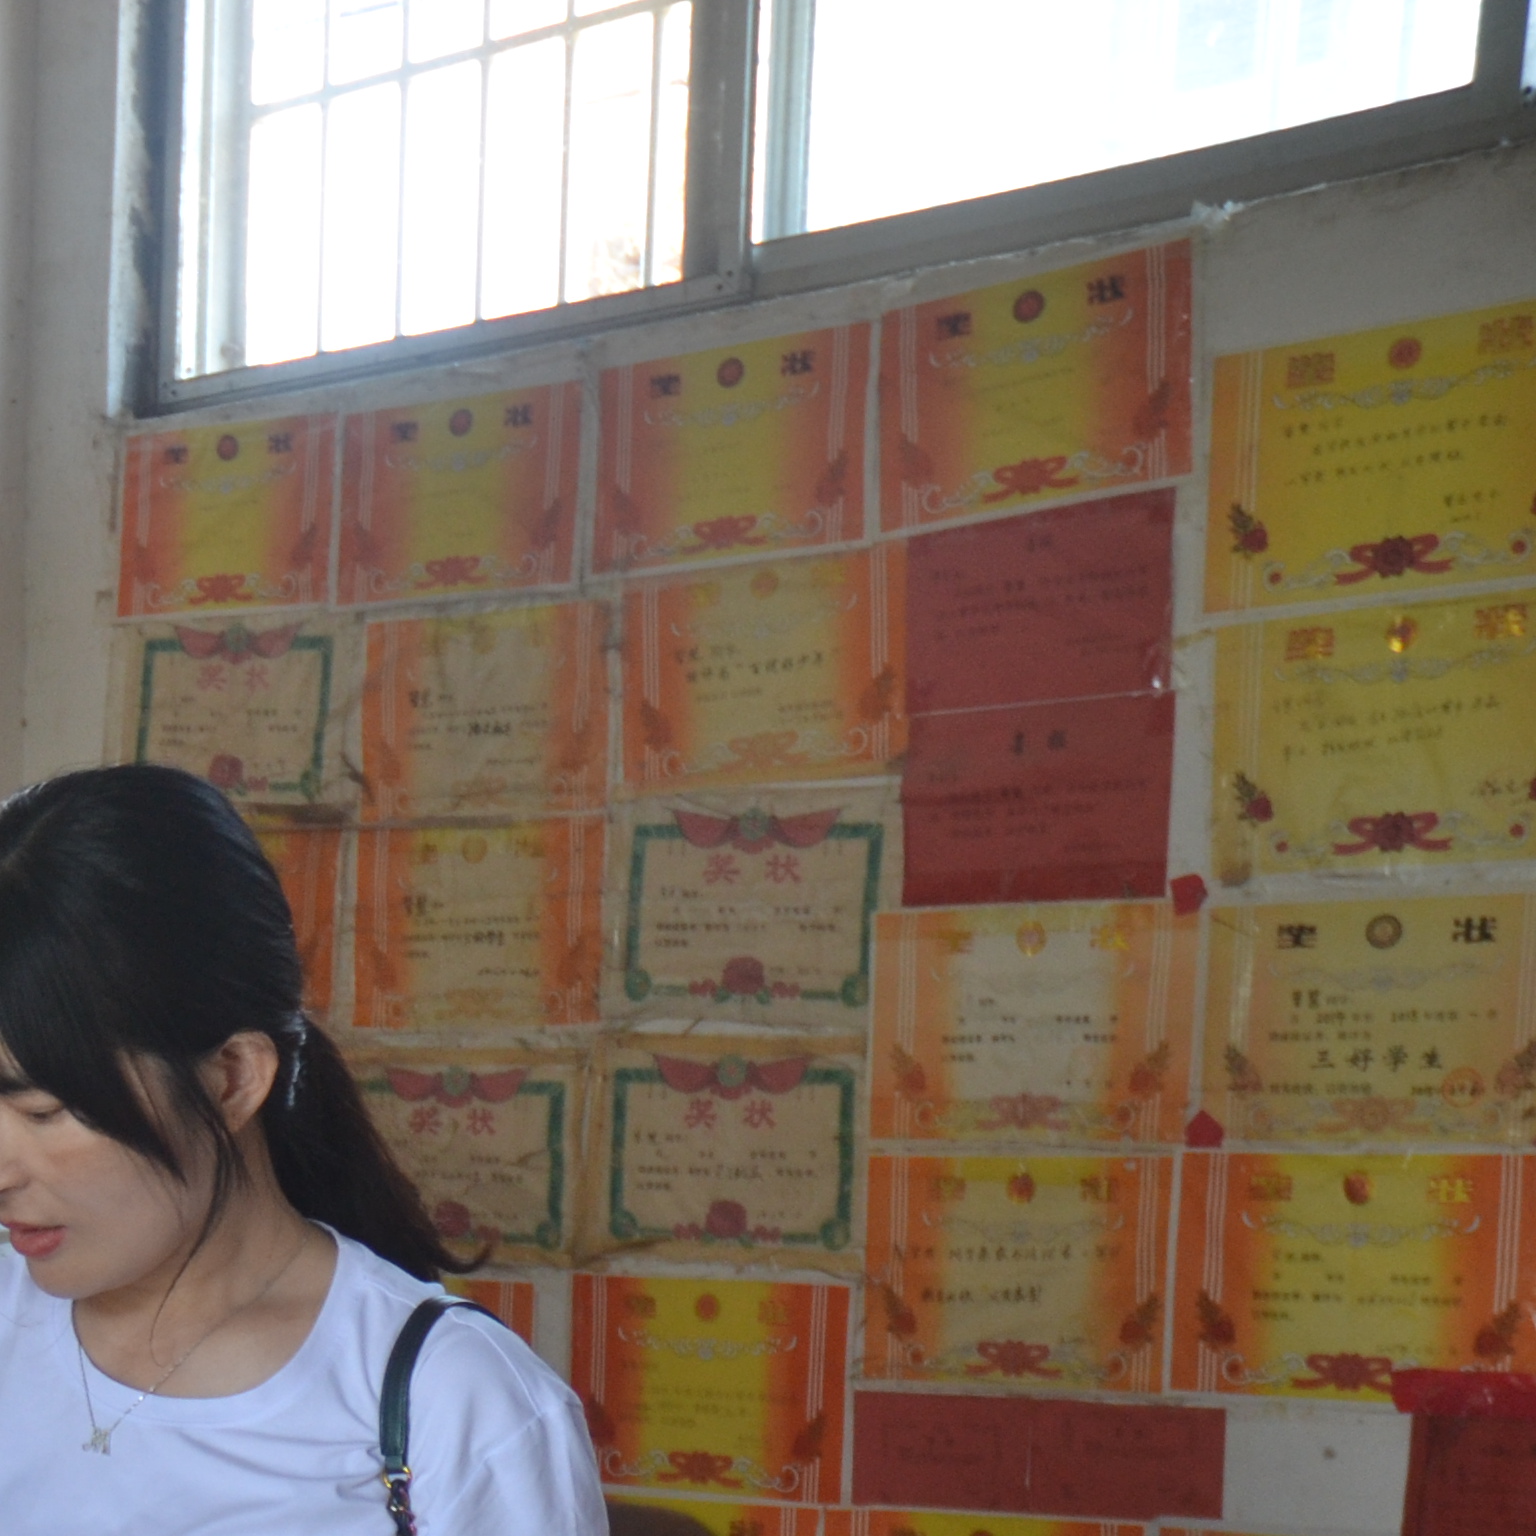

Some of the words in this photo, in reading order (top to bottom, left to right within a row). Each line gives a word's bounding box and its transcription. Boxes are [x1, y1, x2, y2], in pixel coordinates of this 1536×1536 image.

[703, 853, 802, 884] 奖状
[1310, 1044, 1444, 1072] 三好学生
[409, 1106, 497, 1136] 奖状
[684, 1099, 776, 1129] 奖状
